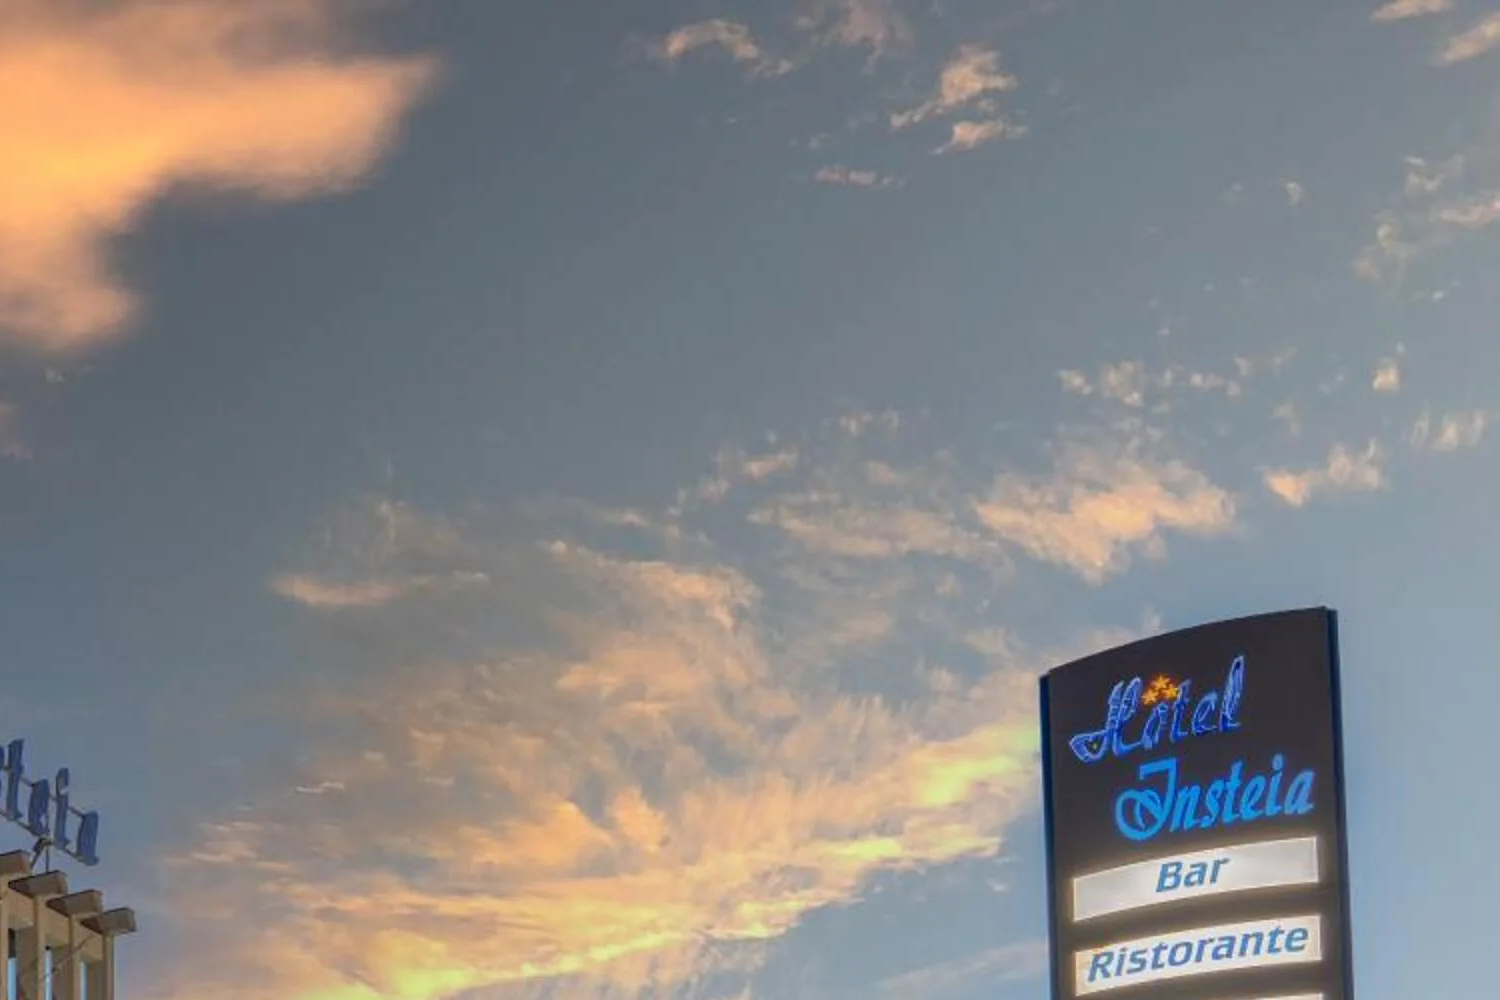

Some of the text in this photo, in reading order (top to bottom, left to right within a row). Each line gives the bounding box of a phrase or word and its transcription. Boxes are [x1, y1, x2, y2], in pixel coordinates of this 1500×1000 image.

[1068, 655, 1245, 763] Hotel
[1115, 753, 1315, 841] Insteia
[1155, 857, 1231, 893] Bar
[1087, 925, 1309, 982] Ristorante
